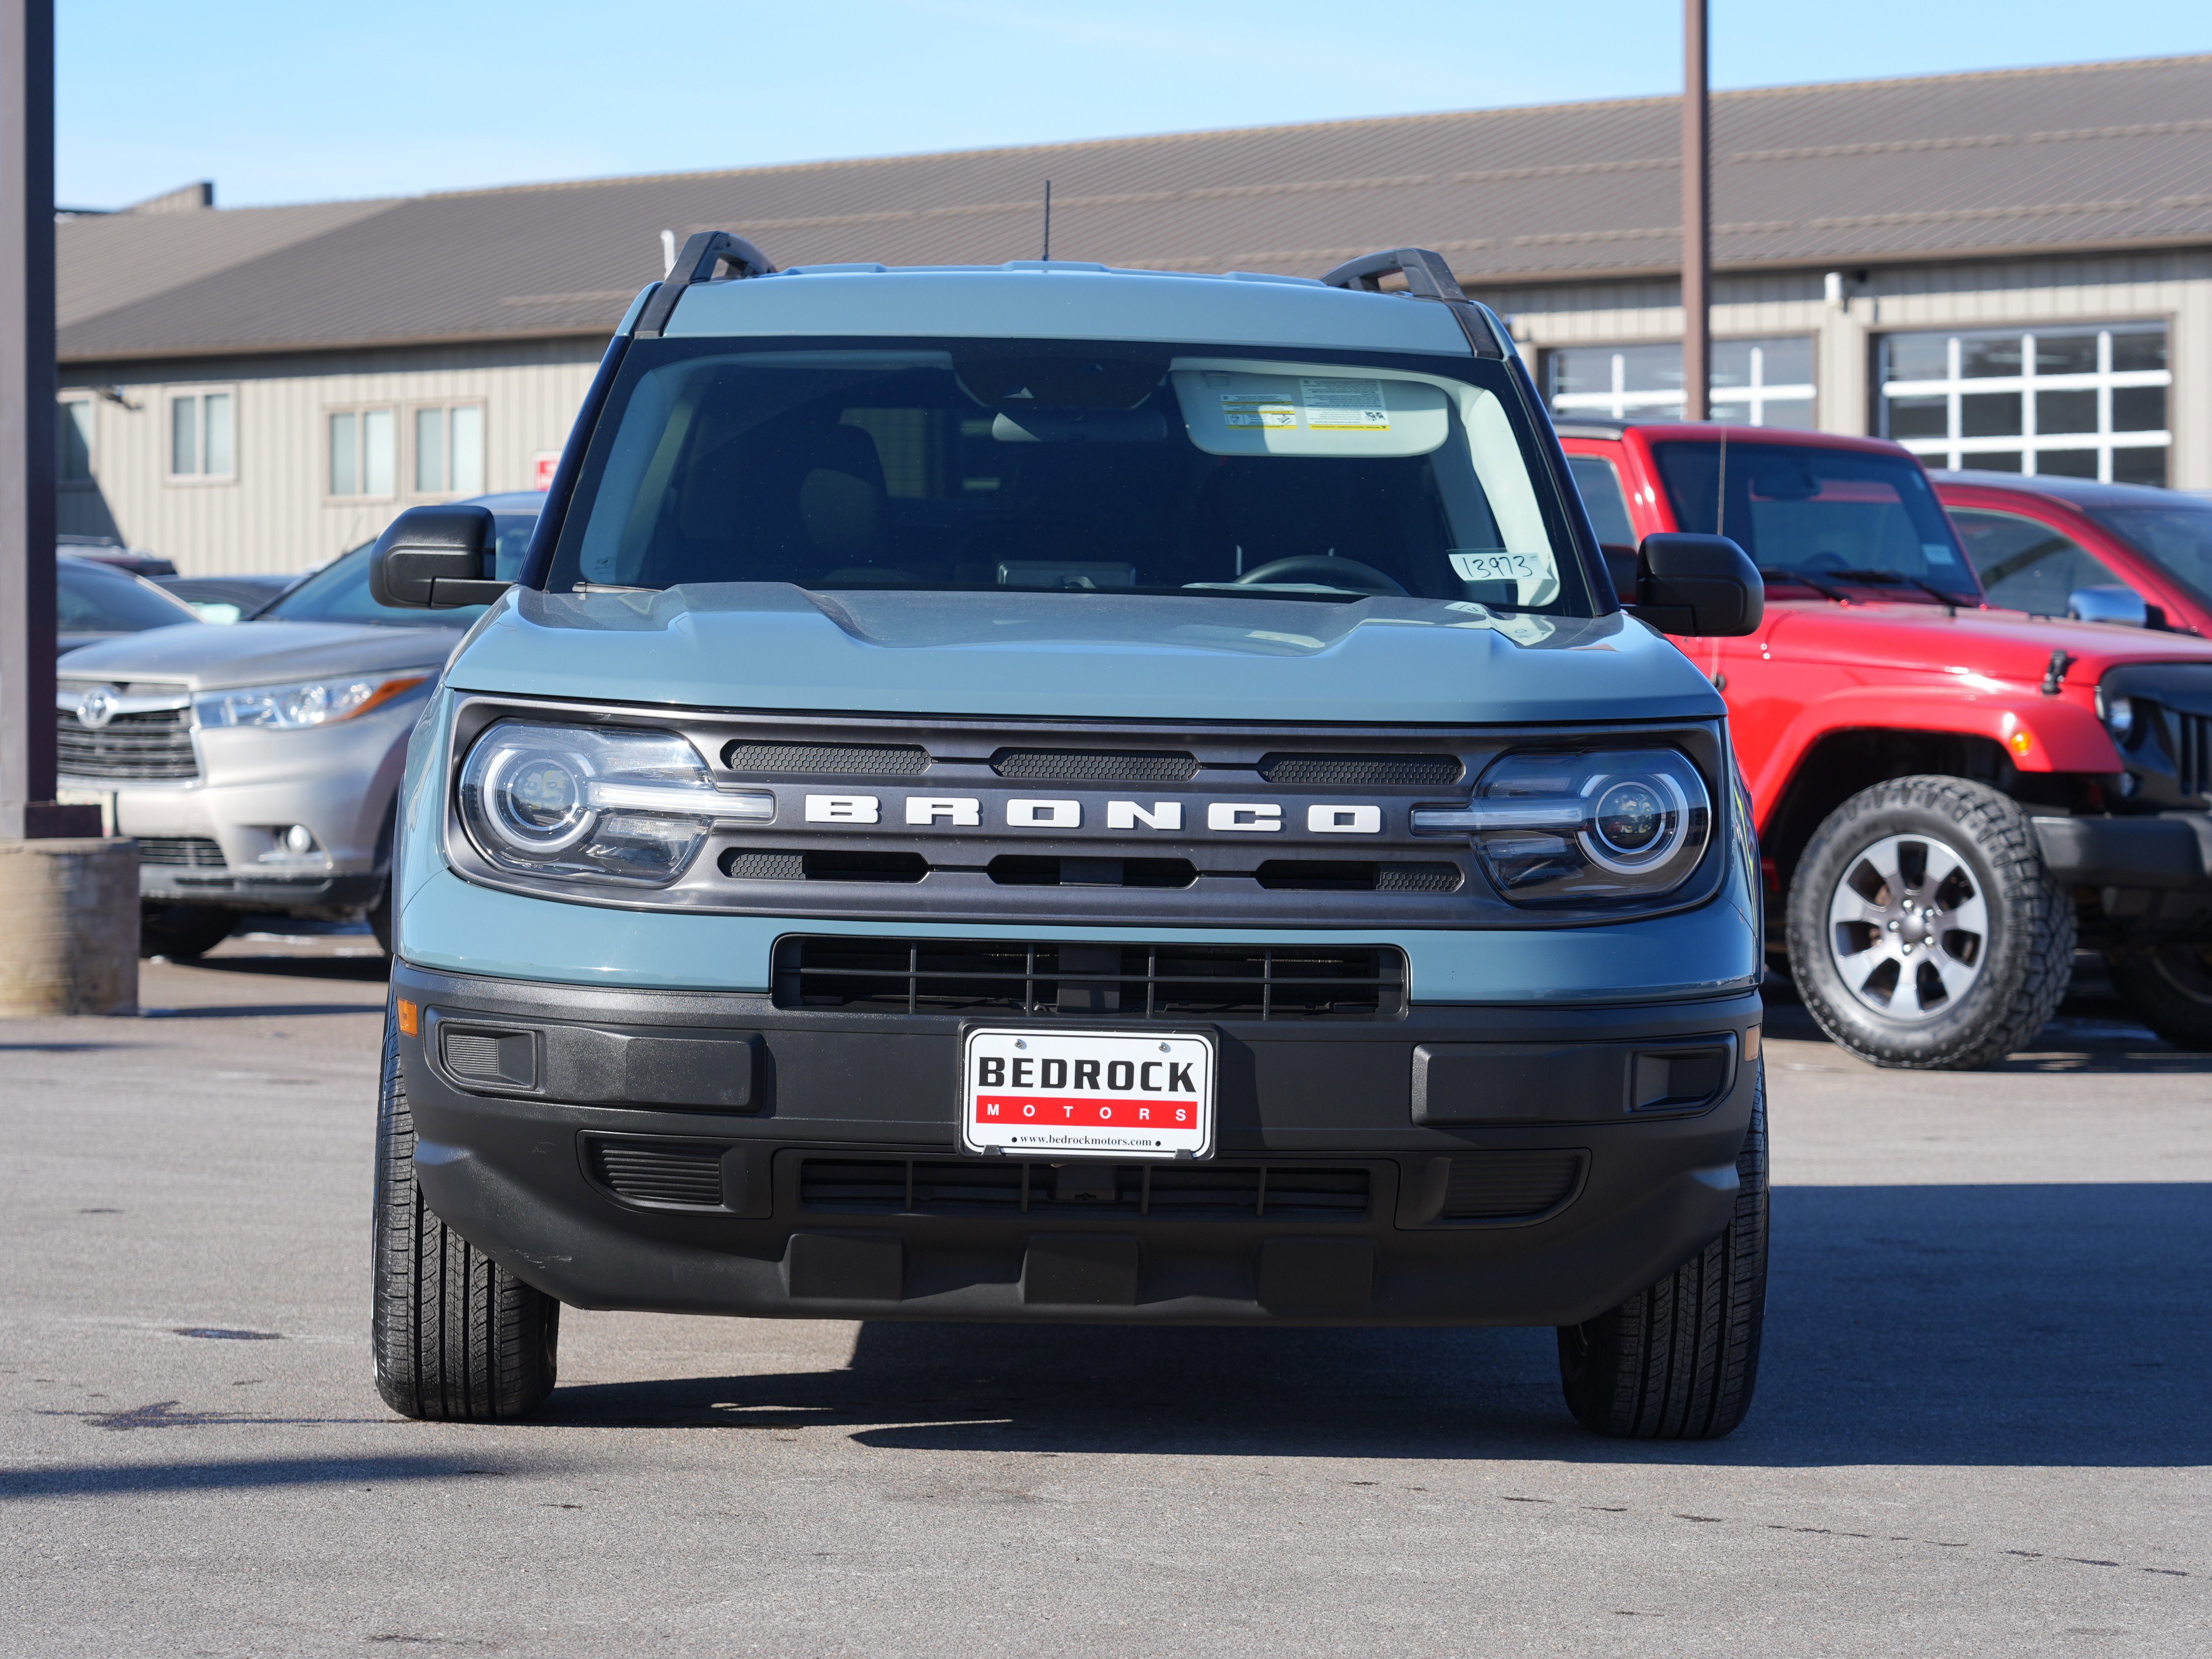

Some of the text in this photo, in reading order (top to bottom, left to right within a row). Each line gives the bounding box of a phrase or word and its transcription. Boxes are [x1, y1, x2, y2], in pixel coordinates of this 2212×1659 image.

[1462, 556, 1533, 578] 13973
[805, 794, 1381, 833] BRONCO
[978, 1057, 1196, 1092] BEDROCK
[987, 1103, 1186, 1122] MOTORS
[1020, 1135, 1151, 1146] www.bedrockmotors.com
